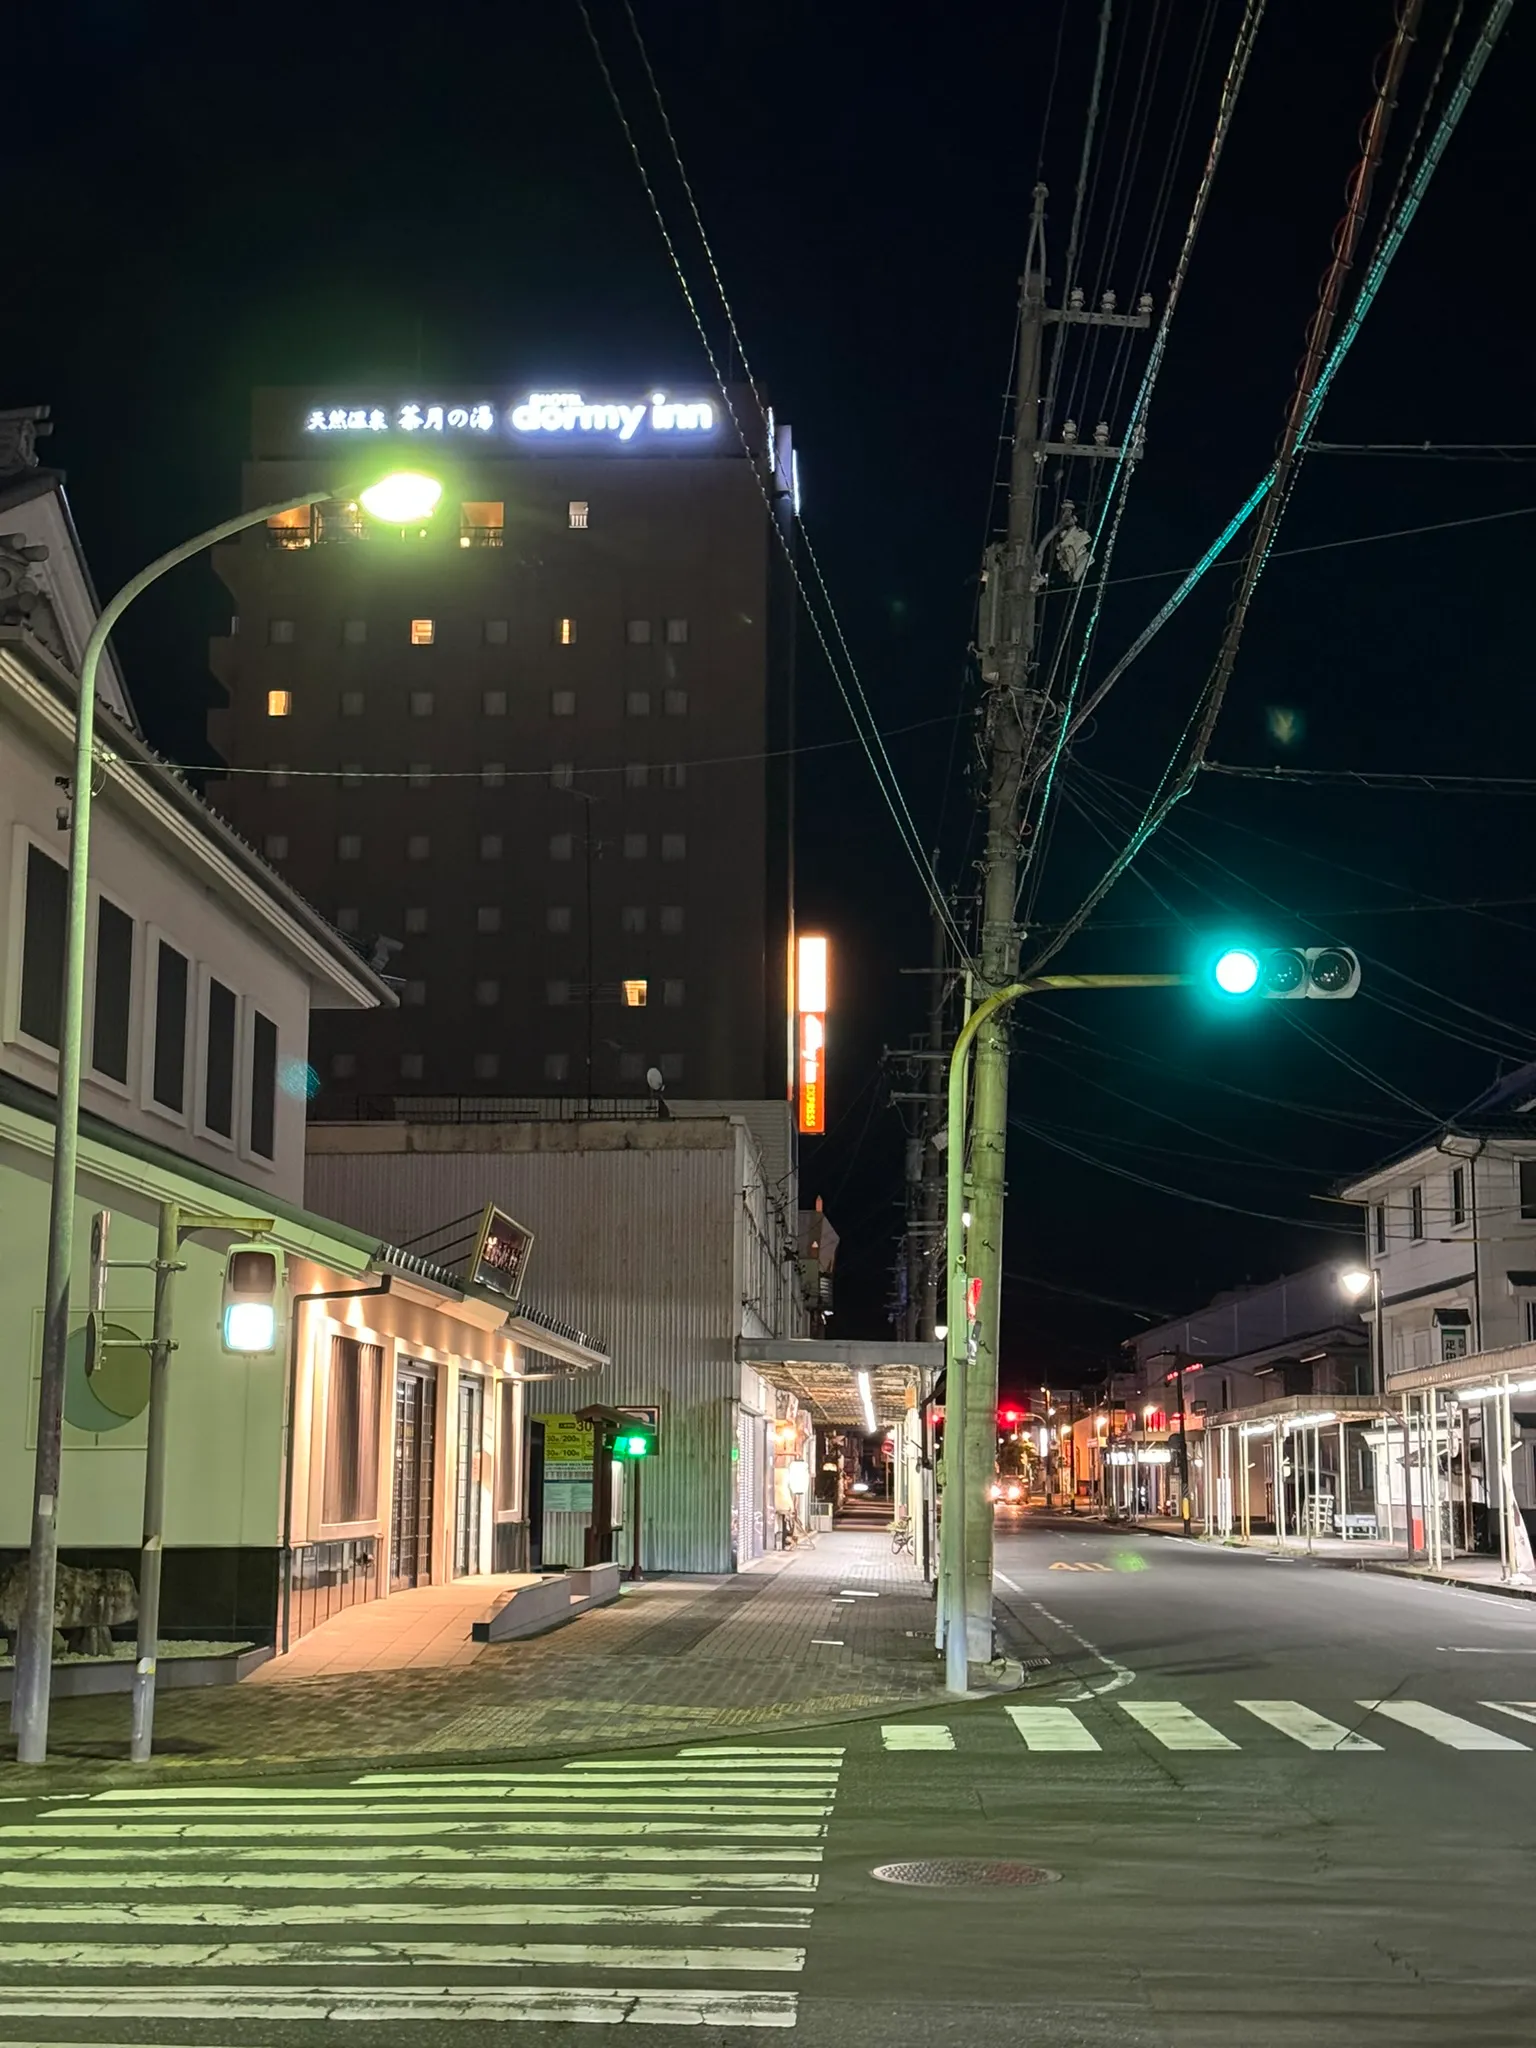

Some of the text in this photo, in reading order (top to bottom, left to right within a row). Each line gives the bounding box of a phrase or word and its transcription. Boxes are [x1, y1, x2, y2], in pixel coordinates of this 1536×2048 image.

[307, 409, 388, 430] 天然温泉
[512, 394, 713, 440] dormy inn
[806, 1083, 816, 1127] EXPRESS
